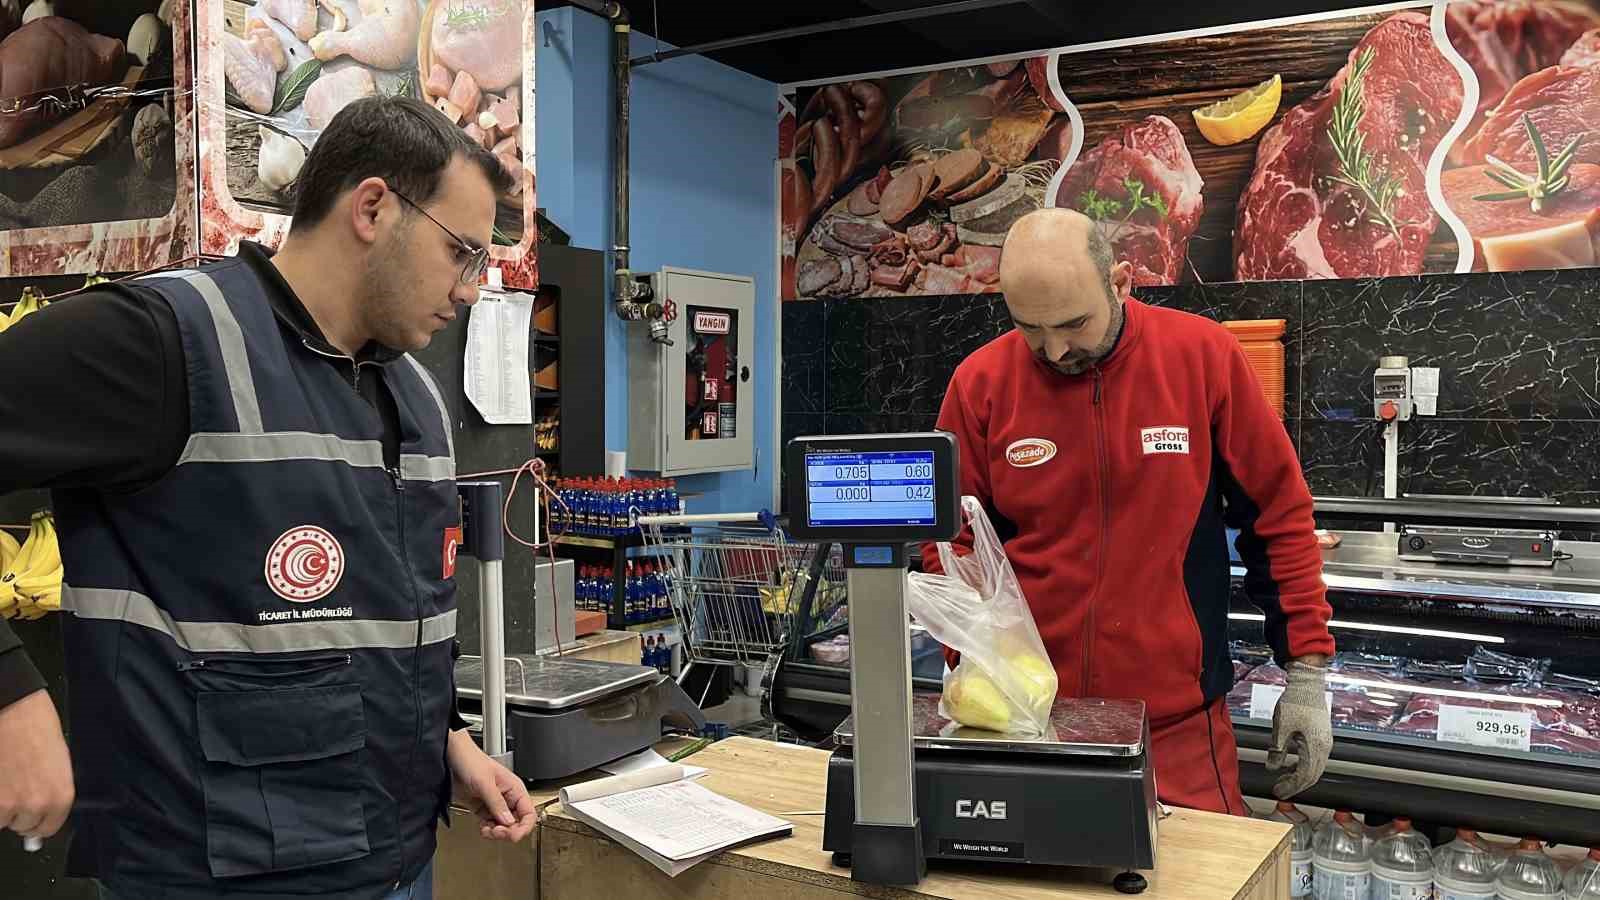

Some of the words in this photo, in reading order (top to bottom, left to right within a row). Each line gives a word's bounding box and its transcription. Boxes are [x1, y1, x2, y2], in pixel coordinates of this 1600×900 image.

[698, 316, 726, 329] YANGIN
[1143, 429, 1188, 443] asfora
[1155, 442, 1183, 451] Gross
[905, 464, 931, 479] 0.60
[906, 485, 932, 500] 0.42
[258, 610, 292, 621] TİCARET
[293, 608, 301, 619] İL
[955, 799, 1008, 820] CAS
